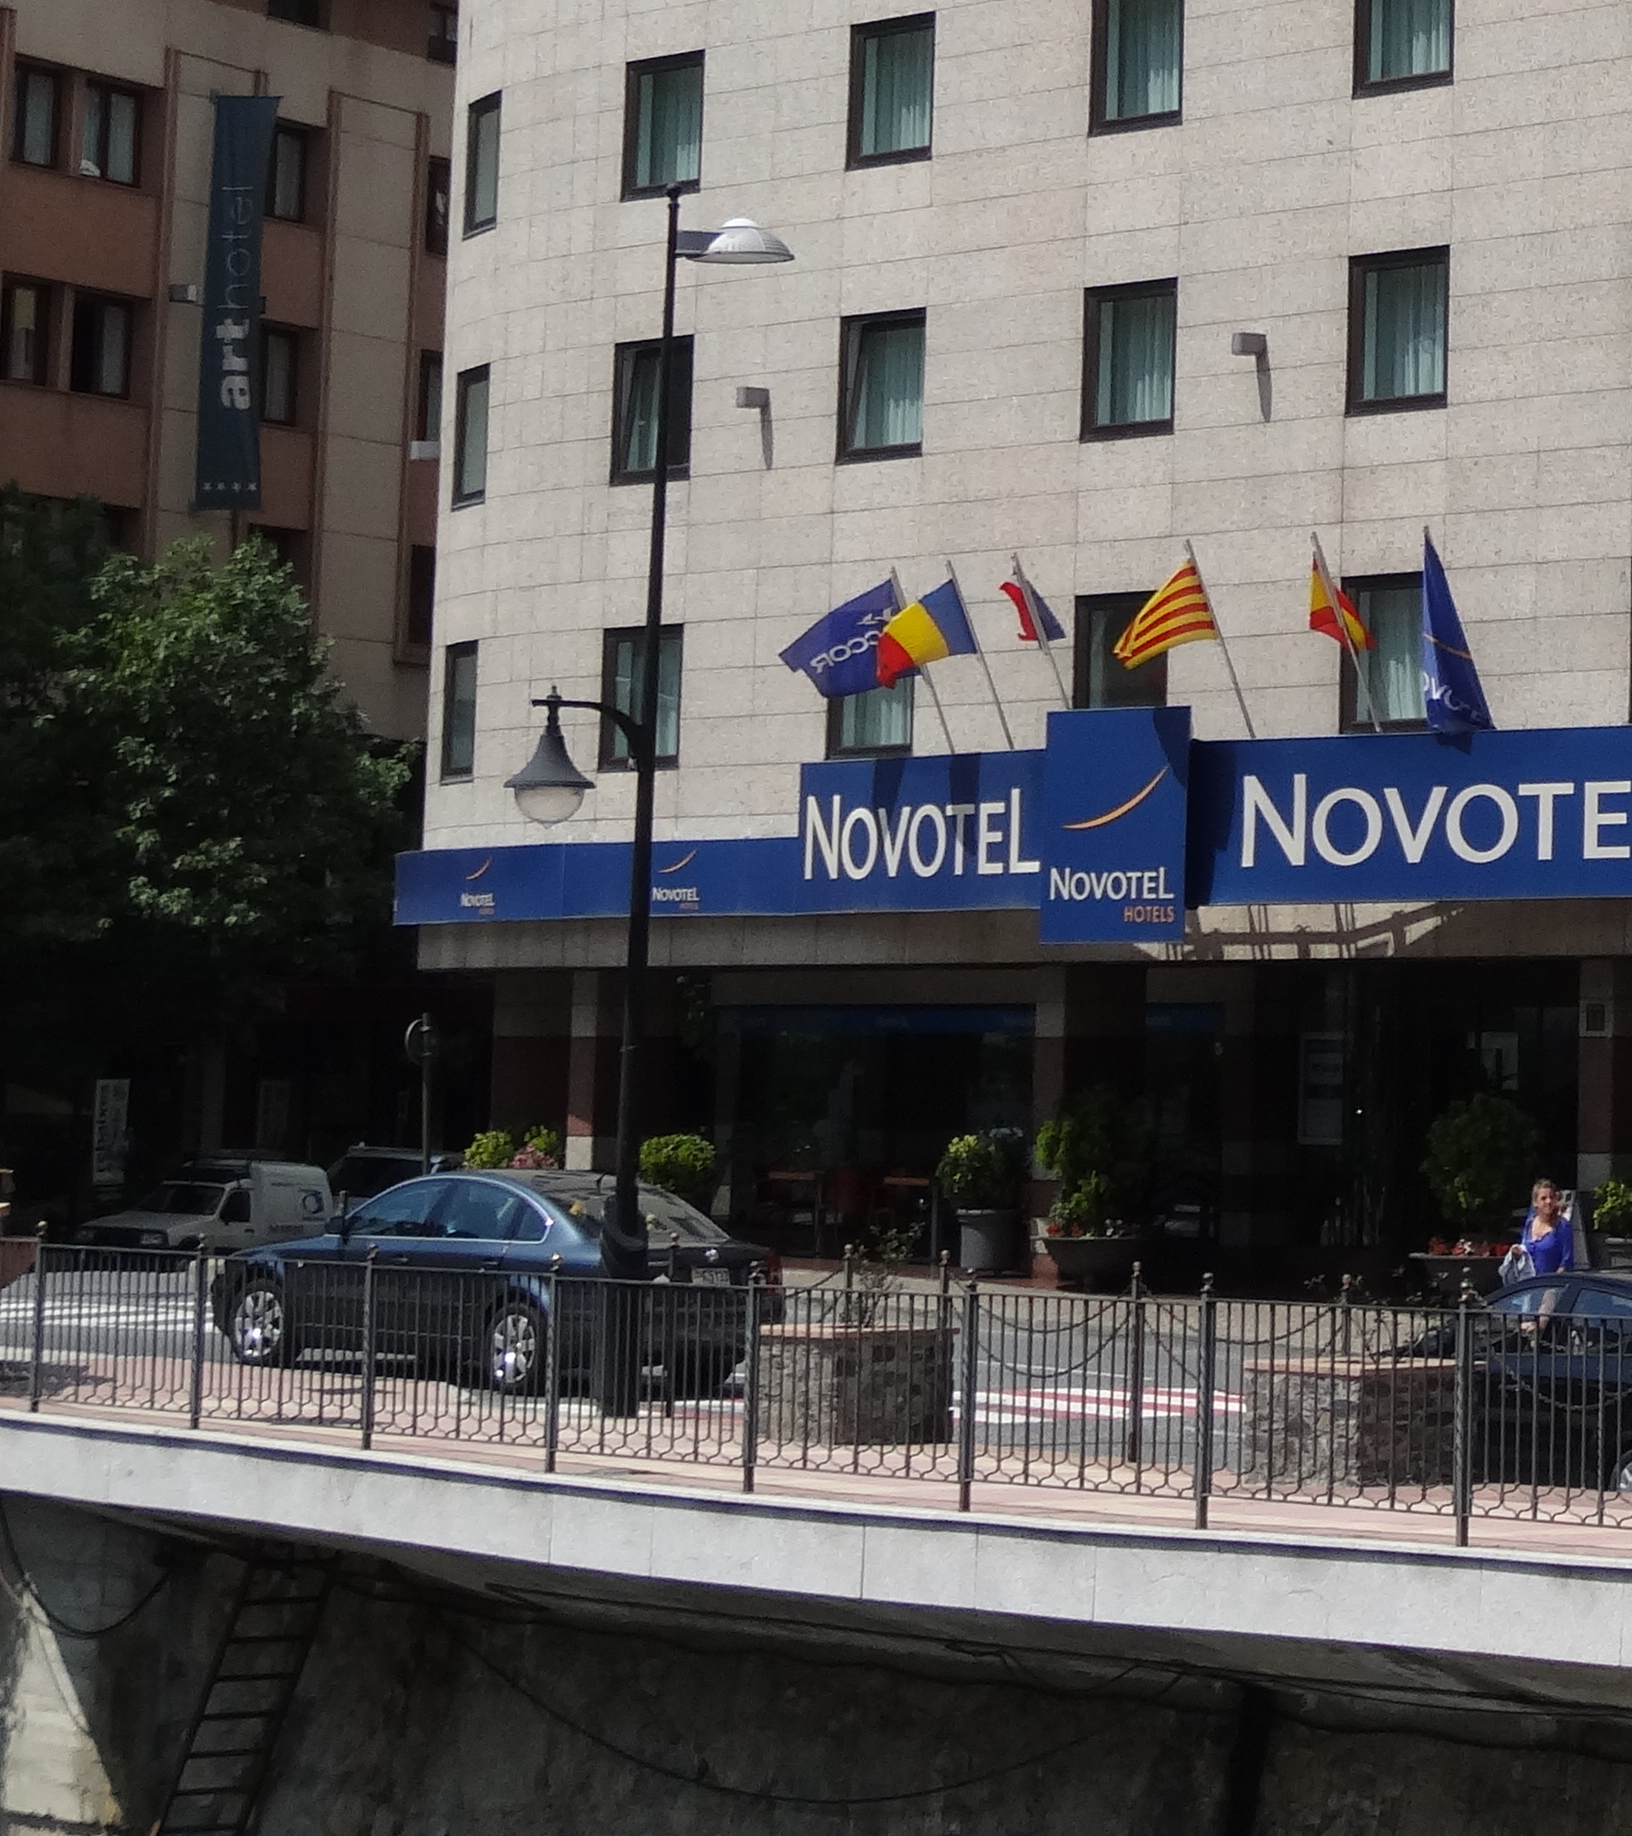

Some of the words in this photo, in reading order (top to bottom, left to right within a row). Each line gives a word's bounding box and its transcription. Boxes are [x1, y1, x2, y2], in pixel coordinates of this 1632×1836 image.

[803, 788, 1041, 880] NOVOTEL
[651, 886, 700, 902] NOVOTEL
[1049, 866, 1175, 902] NOVOTEL
[1123, 904, 1175, 924] HOTELS
